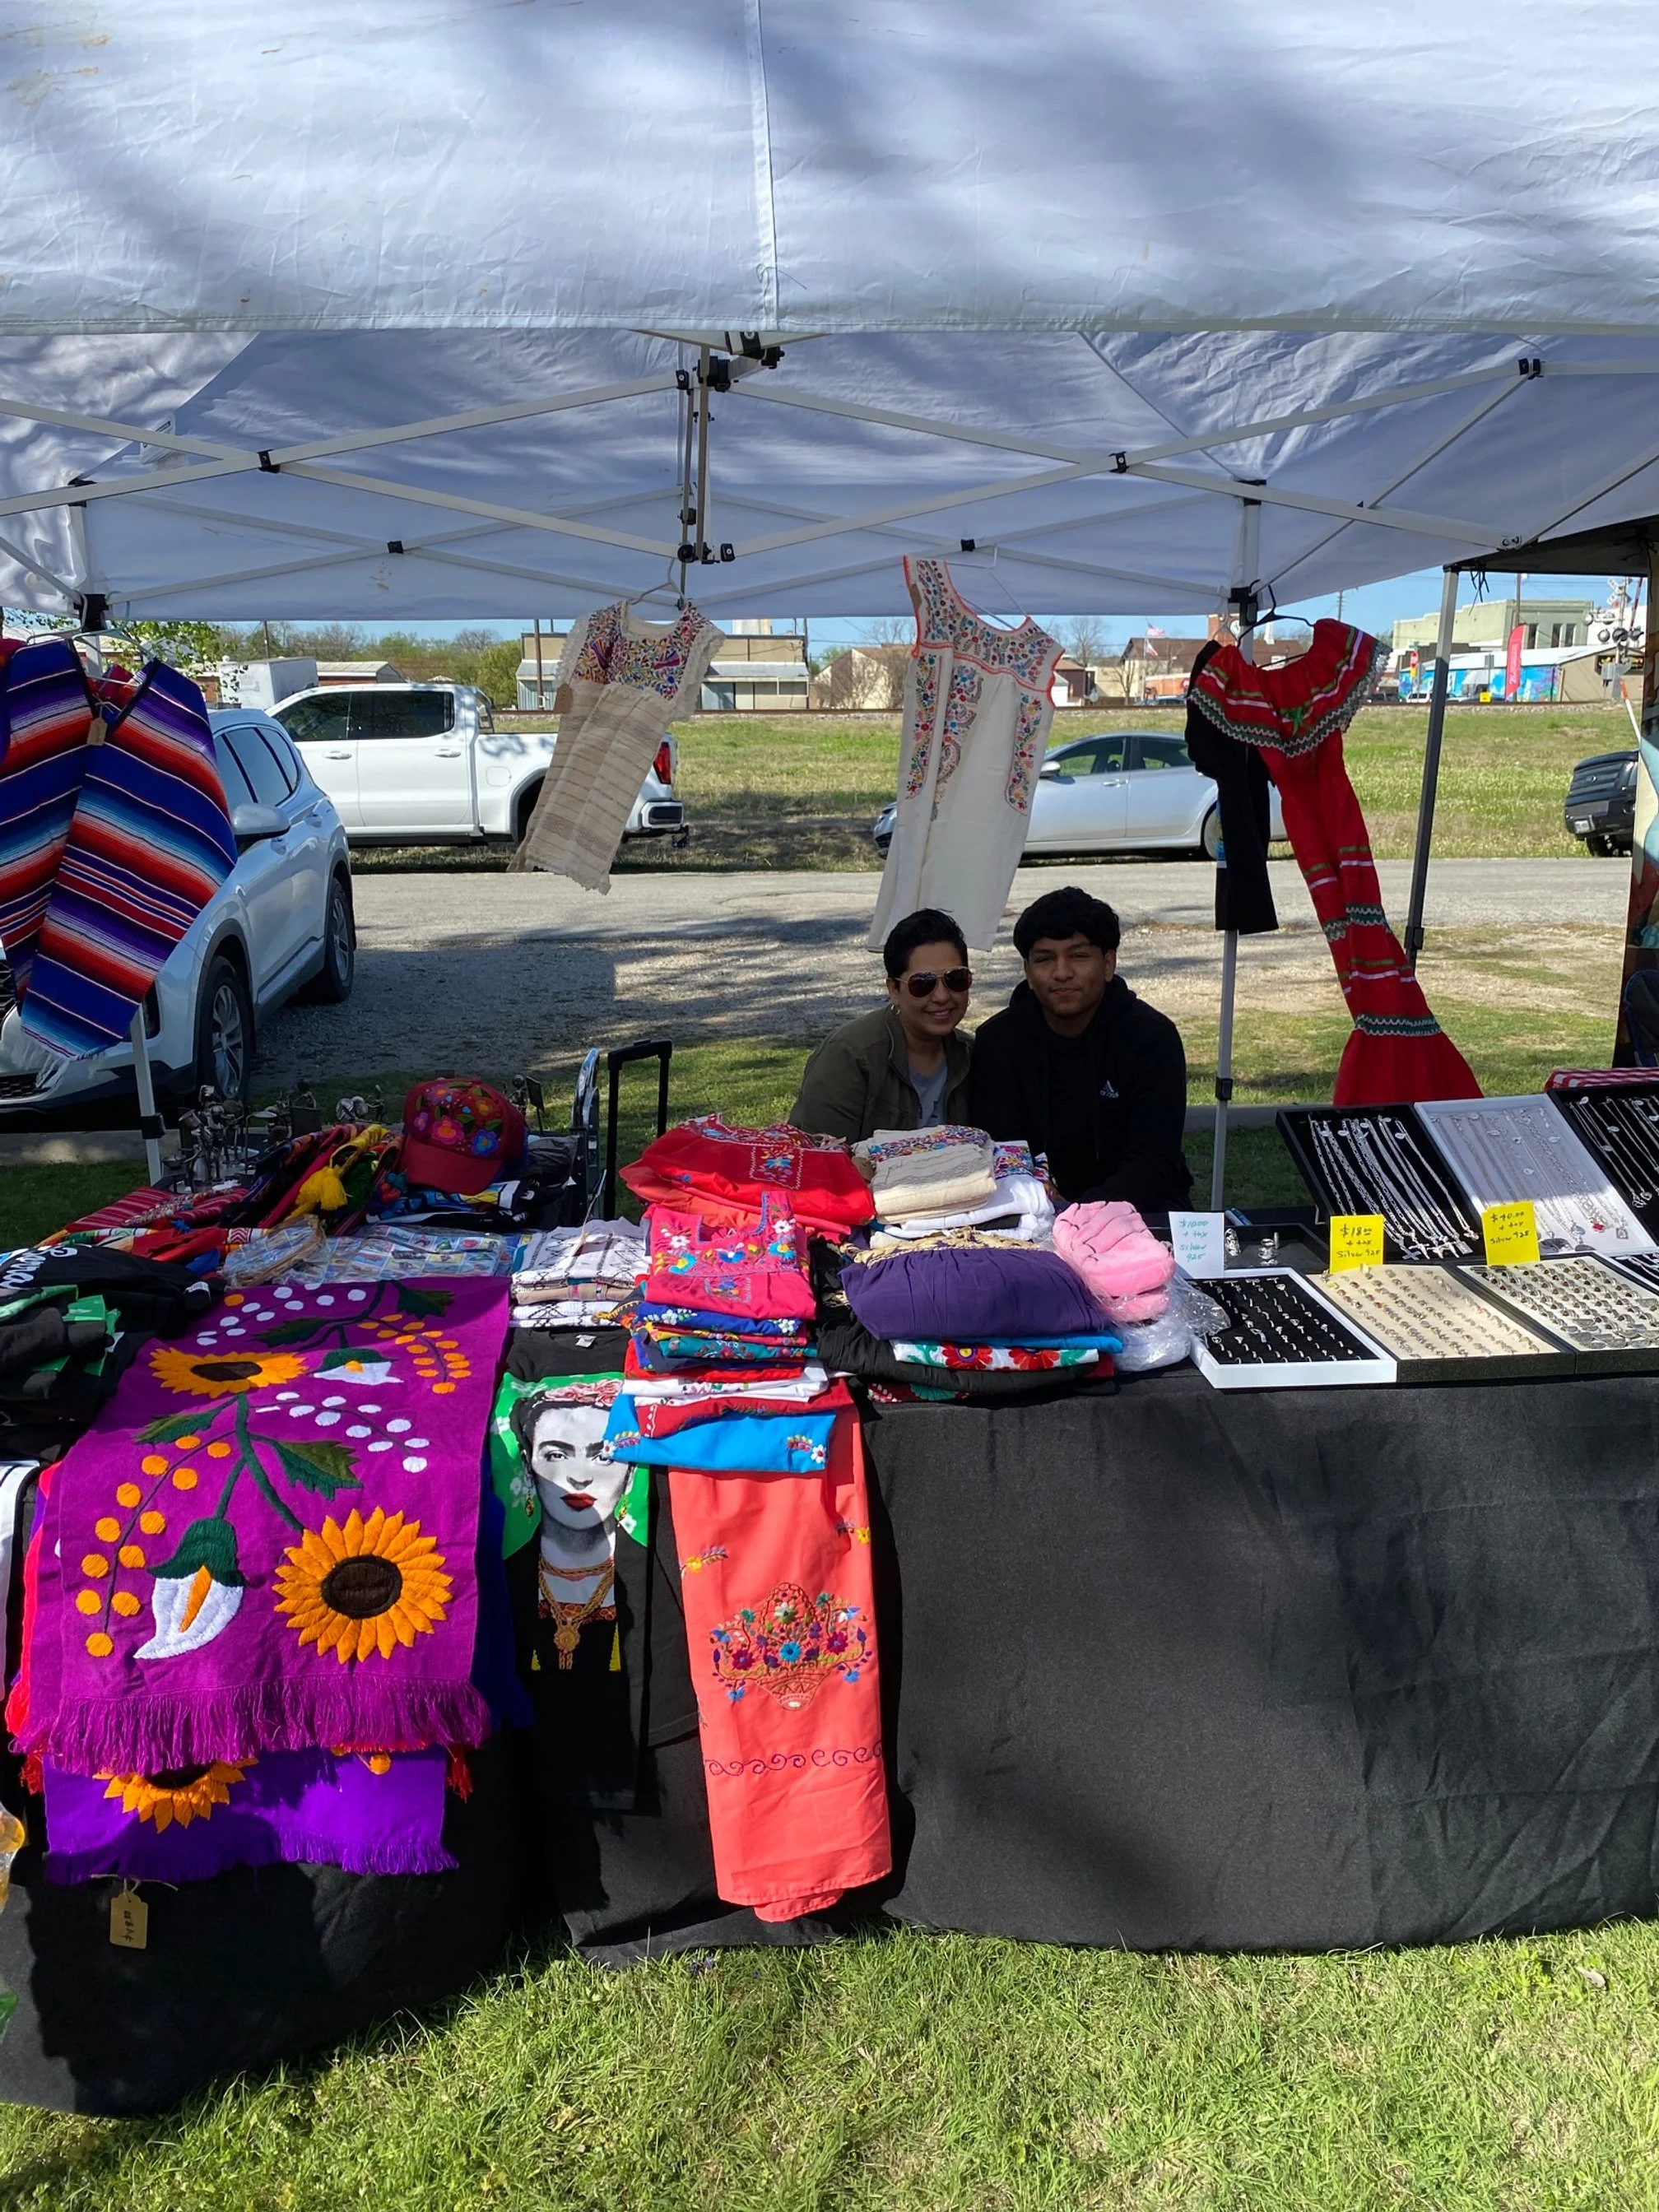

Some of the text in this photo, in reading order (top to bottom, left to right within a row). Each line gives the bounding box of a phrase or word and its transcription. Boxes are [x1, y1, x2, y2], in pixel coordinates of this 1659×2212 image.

[1192, 1230, 1208, 1238] tax
[1186, 1252, 1206, 1262] 925
[1336, 1249, 1364, 1258] Silver
